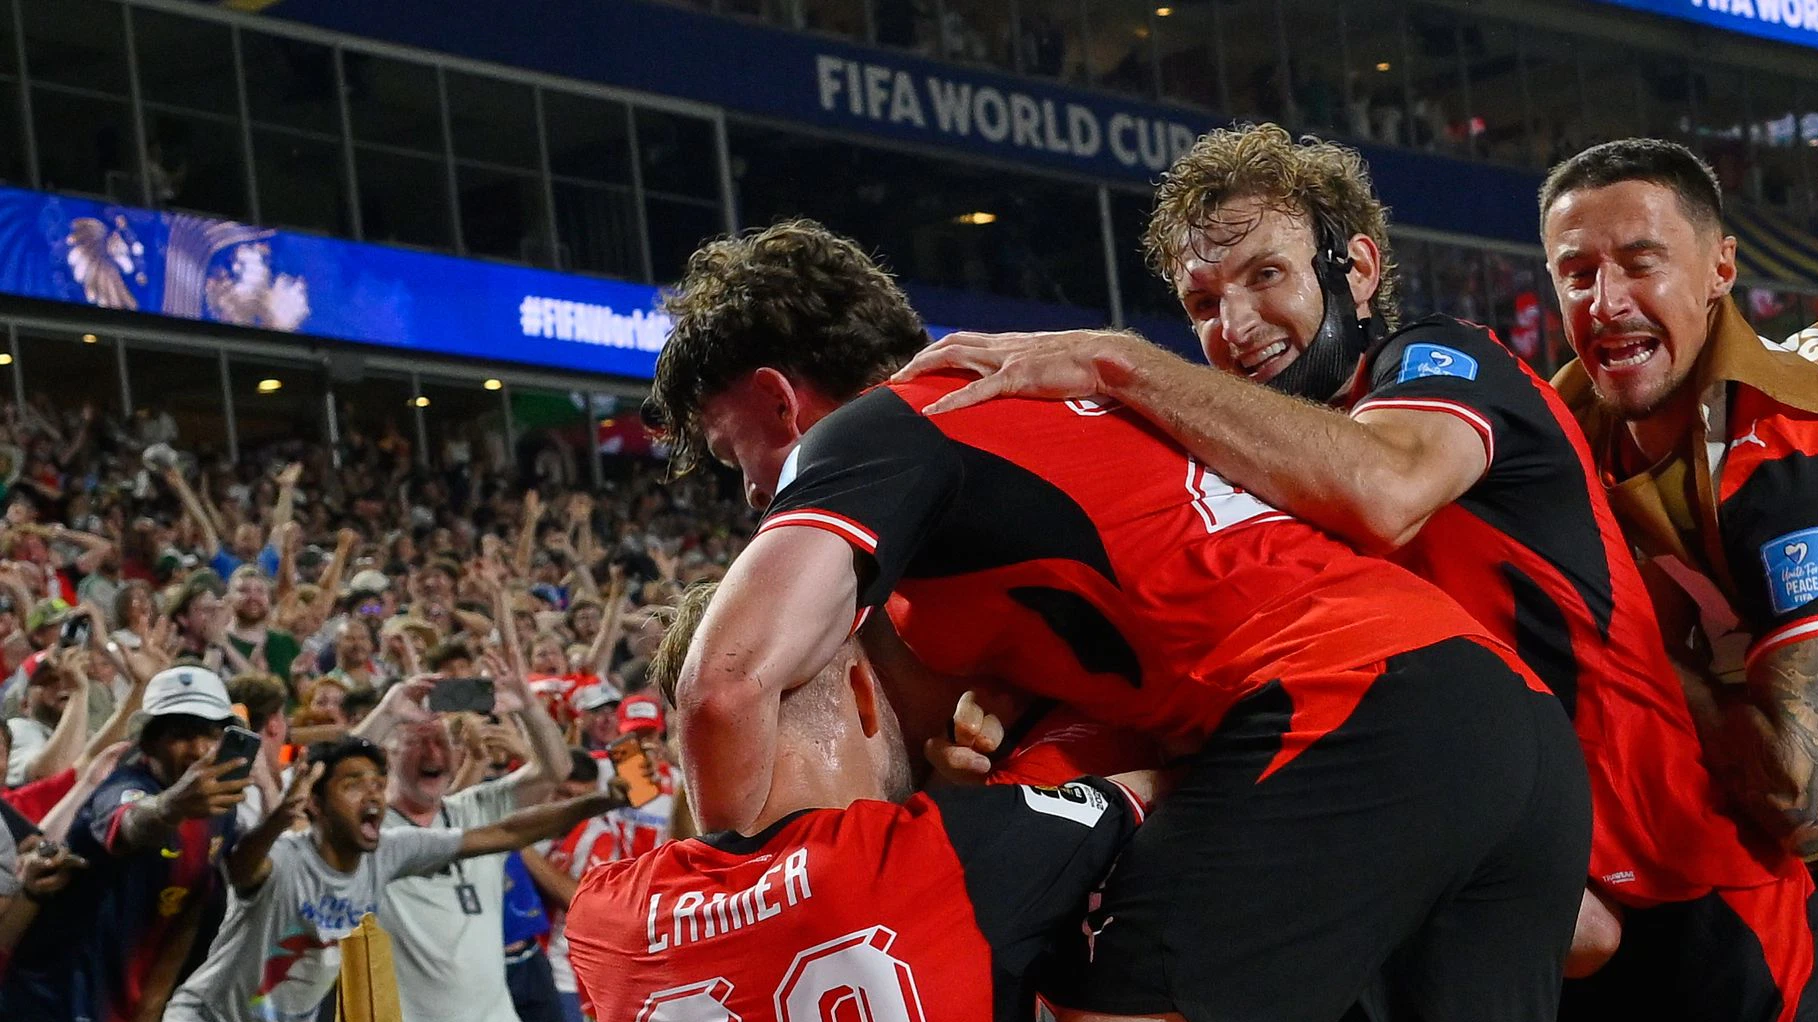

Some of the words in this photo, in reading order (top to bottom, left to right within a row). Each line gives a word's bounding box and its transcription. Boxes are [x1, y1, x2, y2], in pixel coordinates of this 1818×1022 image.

[816, 55, 926, 127] FIFA
[927, 77, 1100, 157] WORLD
[1794, 593, 1814, 603] FIFA
